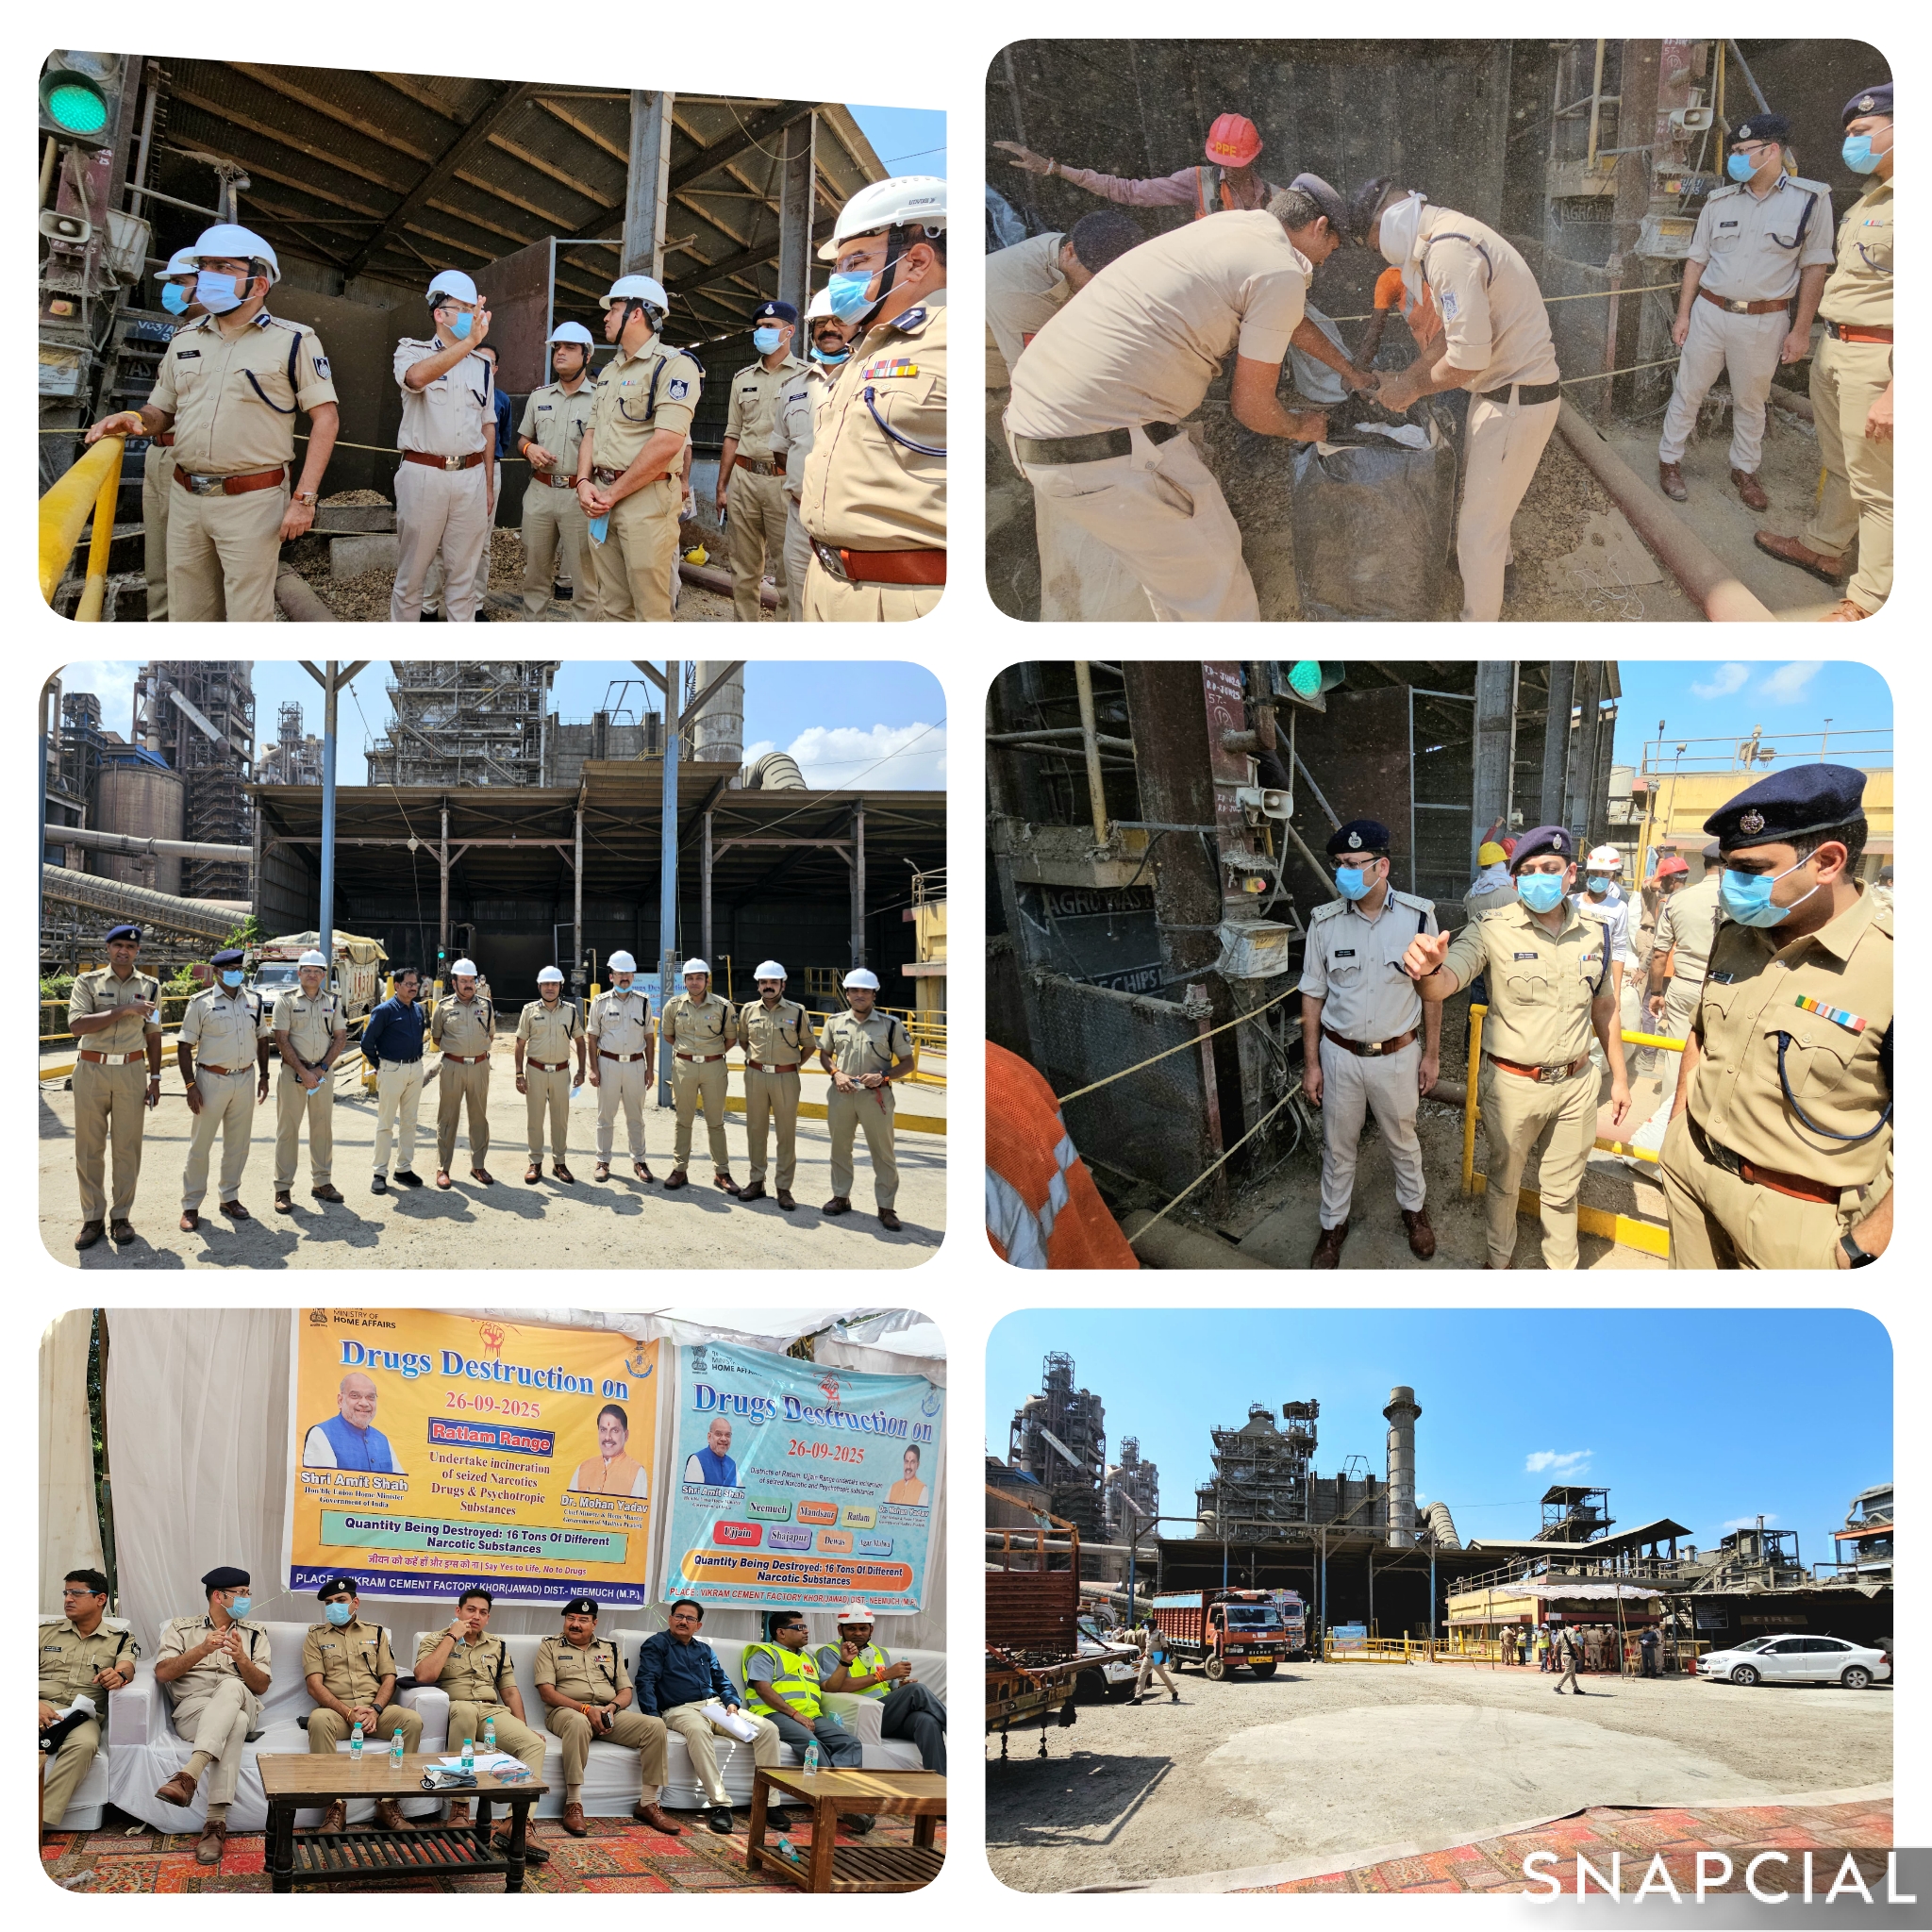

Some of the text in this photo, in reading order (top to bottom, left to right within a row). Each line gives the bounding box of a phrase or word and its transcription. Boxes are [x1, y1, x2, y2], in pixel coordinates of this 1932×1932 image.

[1216, 141, 1236, 158] PPE
[333, 1310, 367, 1318] MINISTRY
[333, 1316, 360, 1325] HOME
[362, 1320, 396, 1329] AFFAIRS
[340, 1340, 629, 1400] Drugs Destruction on
[445, 1392, 541, 1418] 26-09-2025
[692, 1383, 932, 1443] Drugs Destruction on
[433, 1424, 550, 1451] Ratlam Range
[787, 1439, 865, 1464] 26-09-2025
[430, 1452, 550, 1474] Undertake incineration
[750, 1467, 774, 1476] Districts
[301, 1472, 408, 1491] Shri Amit Shah
[442, 1469, 538, 1487] of seized Narcotics
[377, 1492, 404, 1500] Minister
[431, 1482, 545, 1505] Drugs & Psychotropic
[682, 1486, 744, 1499] Shri Amit Shah
[785, 1479, 807, 1488] Narcotic
[850, 1487, 874, 1496] substances
[319, 1497, 361, 1506] Government
[460, 1501, 516, 1515] Substances
[561, 1495, 649, 1513] Dr. Mohan Yadav
[750, 1502, 787, 1514] Neemuch
[799, 1507, 834, 1519] Mandsaur
[847, 1512, 870, 1522] Ratlam
[909, 1508, 929, 1517] Yadav
[345, 1518, 610, 1546] Quantity Being Destroyed: 16 Tons Of Different
[724, 1526, 751, 1538] Ujjain
[771, 1531, 808, 1543] Shajapur
[824, 1536, 845, 1546] Dewas
[859, 1540, 872, 1548] Agar
[427, 1537, 542, 1554] Narcotic Substances
[368, 1554, 389, 1564] जीवन
[391, 1555, 403, 1566] को
[430, 1557, 443, 1568] और
[460, 1559, 470, 1569] को
[471, 1562, 479, 1570] ना
[485, 1562, 498, 1572] Say
[525, 1564, 541, 1573] Life,
[565, 1567, 586, 1575] Drugs
[694, 1555, 903, 1576] Quantity Being Destroyed: 16 Tons Of Different
[296, 1574, 334, 1584] PLACE
[343, 1576, 386, 1587] KRAM
[389, 1579, 431, 1590] CEMENT
[433, 1581, 478, 1591] FACTORY
[479, 1583, 542, 1596] KHOR(JAWAD)
[570, 1588, 614, 1598] NEEMUCH
[616, 1590, 640, 1600] (M.P.)
[757, 1572, 851, 1585] Narcotic Substances
[669, 1588, 695, 1596] PLACE
[700, 1589, 730, 1597] VIKRAM
[732, 1590, 764, 1599] CEMENT
[766, 1592, 802, 1601] FACTORY
[804, 1594, 849, 1604] KHOR(JAWAD)
